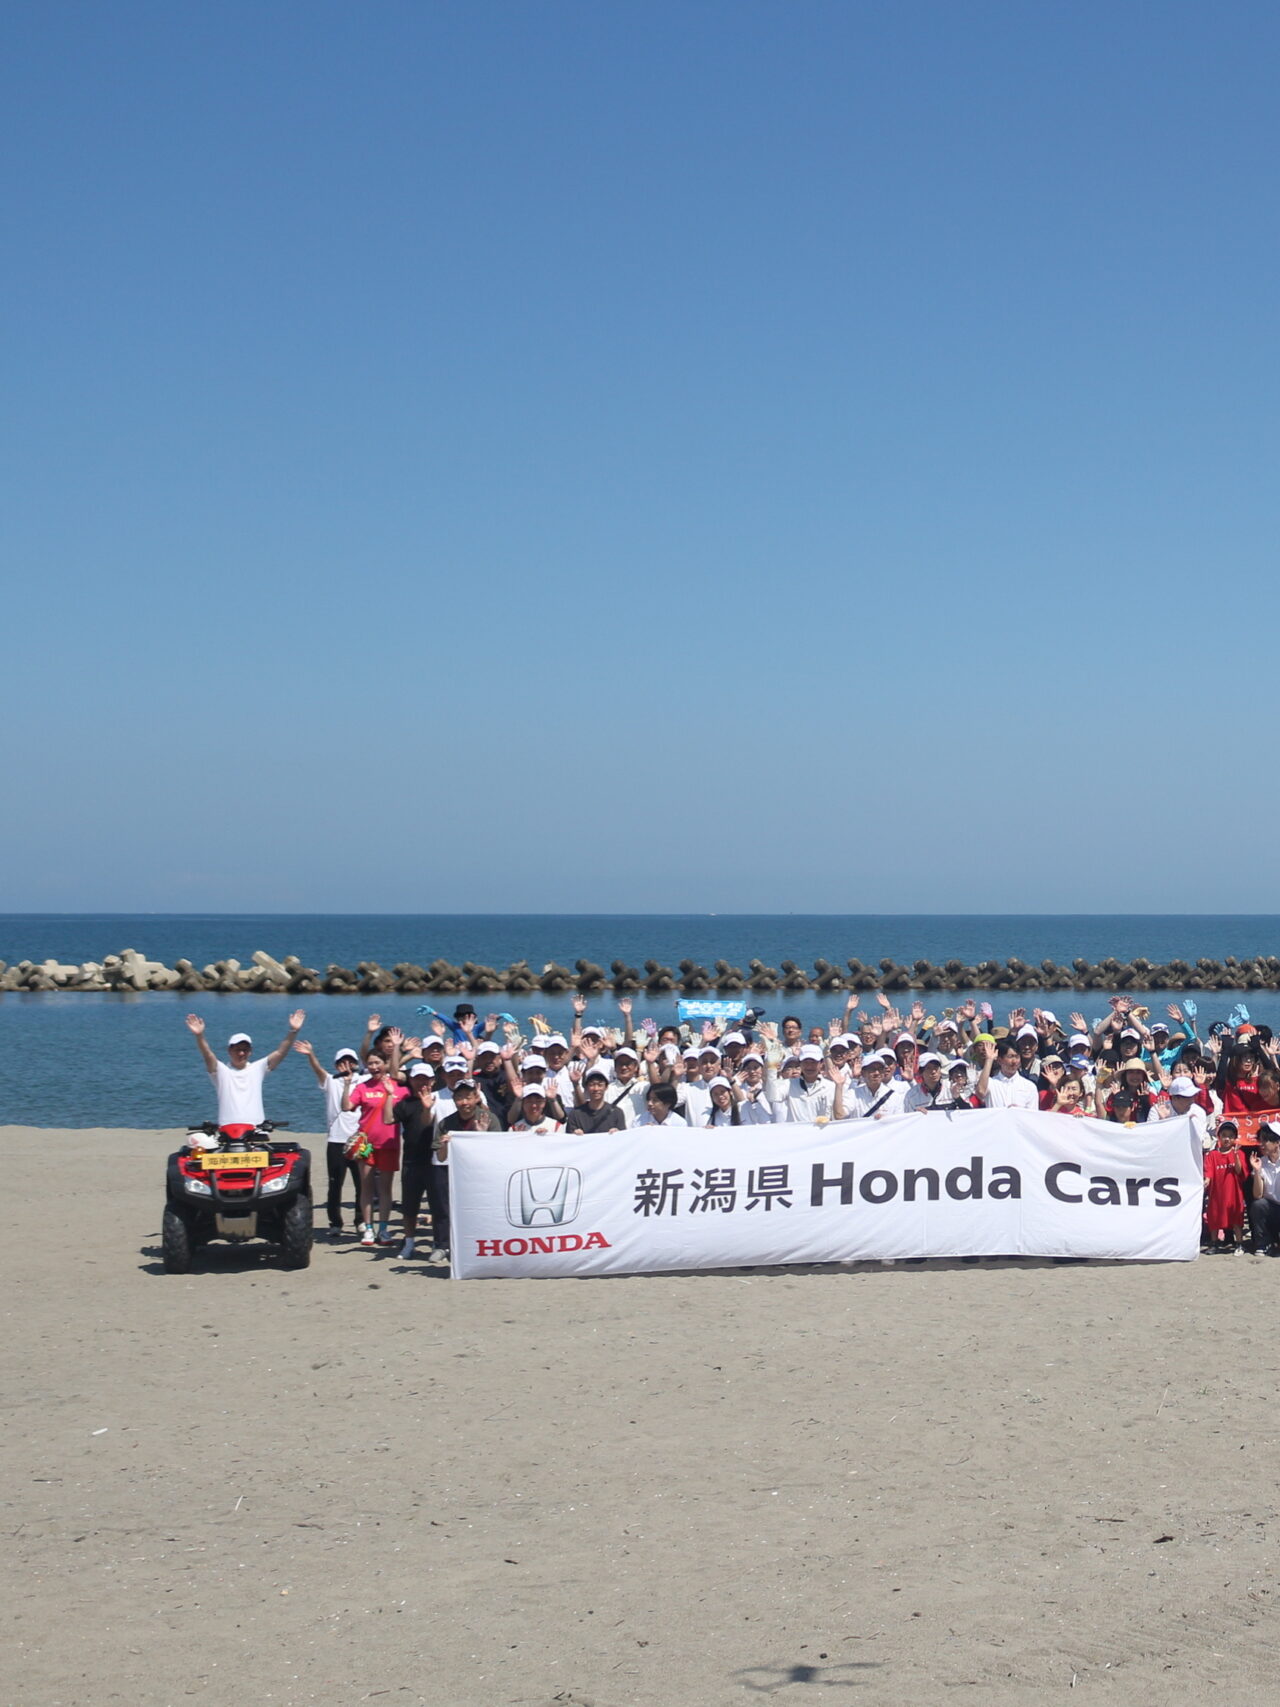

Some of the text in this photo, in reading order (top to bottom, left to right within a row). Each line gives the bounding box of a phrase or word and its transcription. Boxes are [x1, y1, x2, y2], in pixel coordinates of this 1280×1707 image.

[633, 1156, 1182, 1217] 新潟県 Honda Cars
[476, 1232, 612, 1256] HONDA
